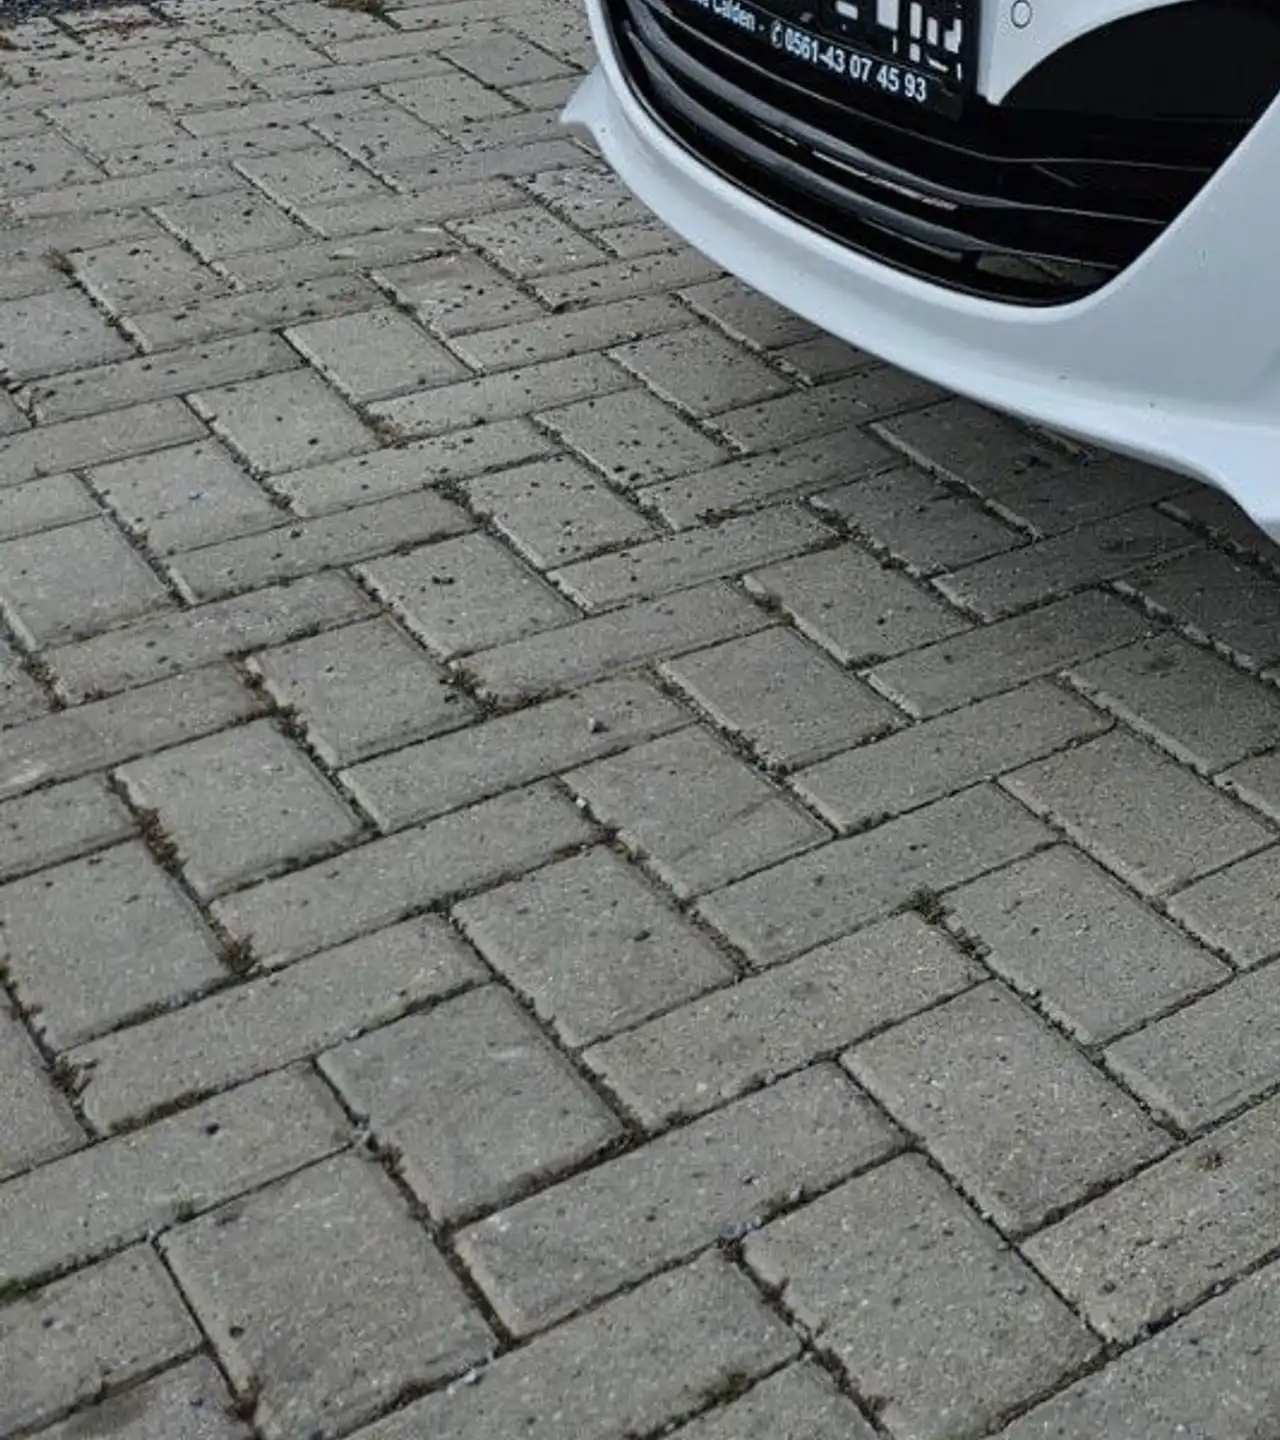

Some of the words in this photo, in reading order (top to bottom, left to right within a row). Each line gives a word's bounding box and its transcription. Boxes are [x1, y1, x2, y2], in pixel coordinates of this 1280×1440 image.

[785, 27, 846, 73] 0561-43
[849, 54, 872, 83] 07
[876, 64, 900, 92] 45
[904, 72, 927, 103] 93
